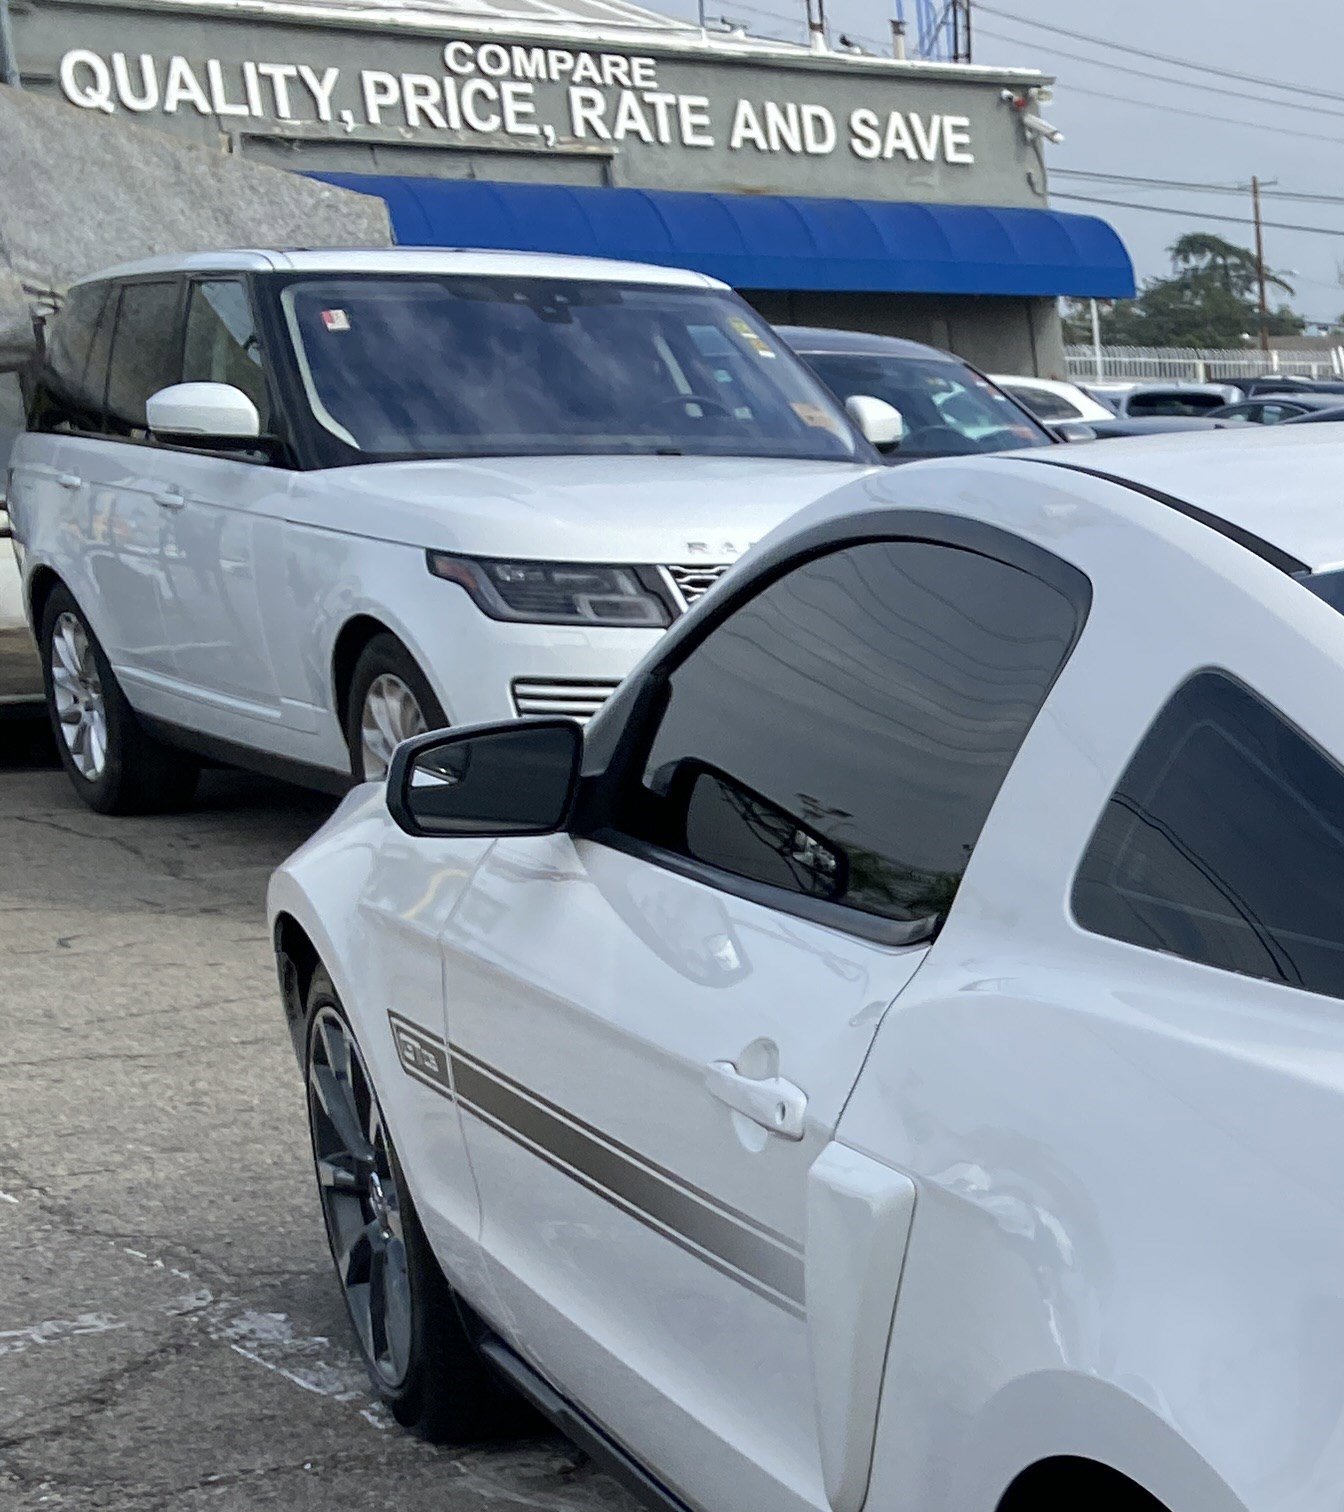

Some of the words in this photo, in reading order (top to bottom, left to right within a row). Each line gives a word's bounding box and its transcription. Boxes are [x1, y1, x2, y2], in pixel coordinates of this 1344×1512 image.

[444, 40, 659, 89] COMPARE
[59, 48, 356, 133] QUALITY,
[361, 70, 556, 147] PRICE,
[569, 86, 716, 147] RATE
[730, 99, 836, 155] AND
[850, 109, 975, 165] SAVE
